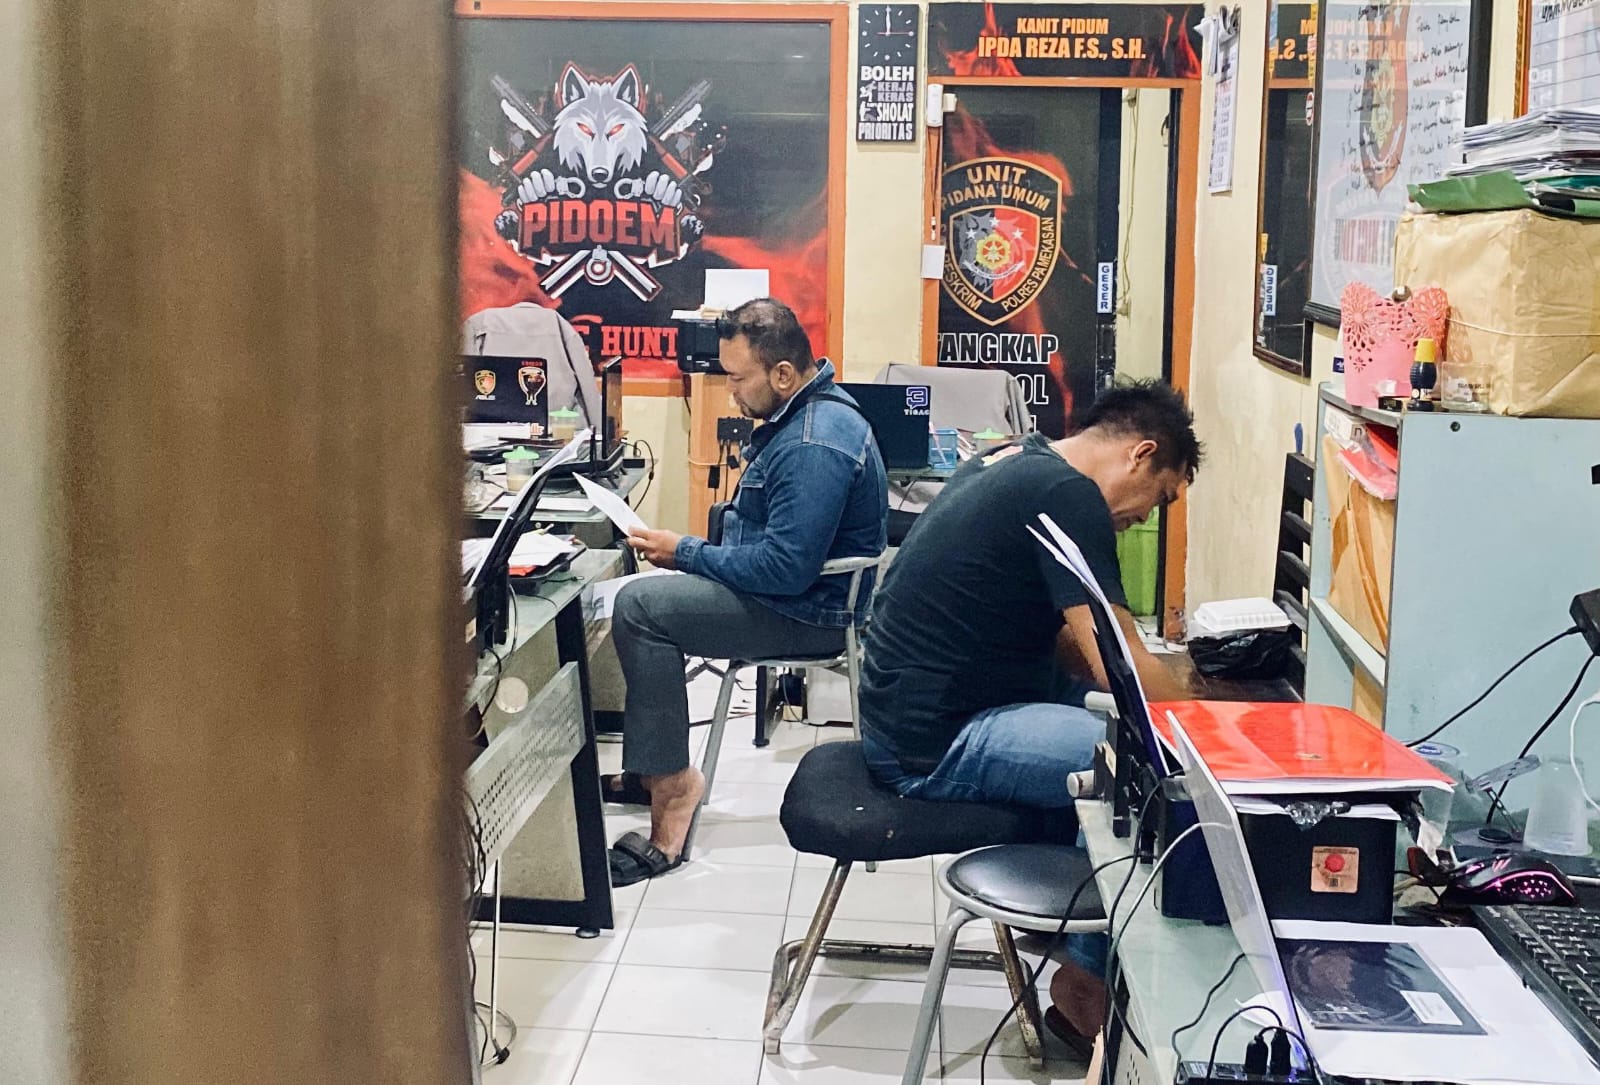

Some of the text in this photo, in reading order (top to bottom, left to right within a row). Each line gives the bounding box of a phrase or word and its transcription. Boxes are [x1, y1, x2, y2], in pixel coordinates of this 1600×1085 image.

[1016, 17, 1109, 35] KANIT PIDUM
[978, 36, 1022, 58] IPDA
[1025, 37, 1071, 58] REZA
[1111, 38, 1146, 59] S.H.
[860, 65, 915, 81] BOLEH
[877, 81, 914, 92] KERJA
[877, 92, 914, 102] KERAS
[876, 102, 914, 122] SHOLAT
[858, 122, 913, 140] PRIORITAS
[966, 164, 1027, 185] UNIT
[1001, 184, 1051, 211] UMUM
[522, 199, 675, 252] PIDOEM
[1001, 216, 1056, 312] POLRES PAMEKASAN
[1100, 265, 1110, 310] GESER
[938, 332, 1059, 364] ANGKAP
